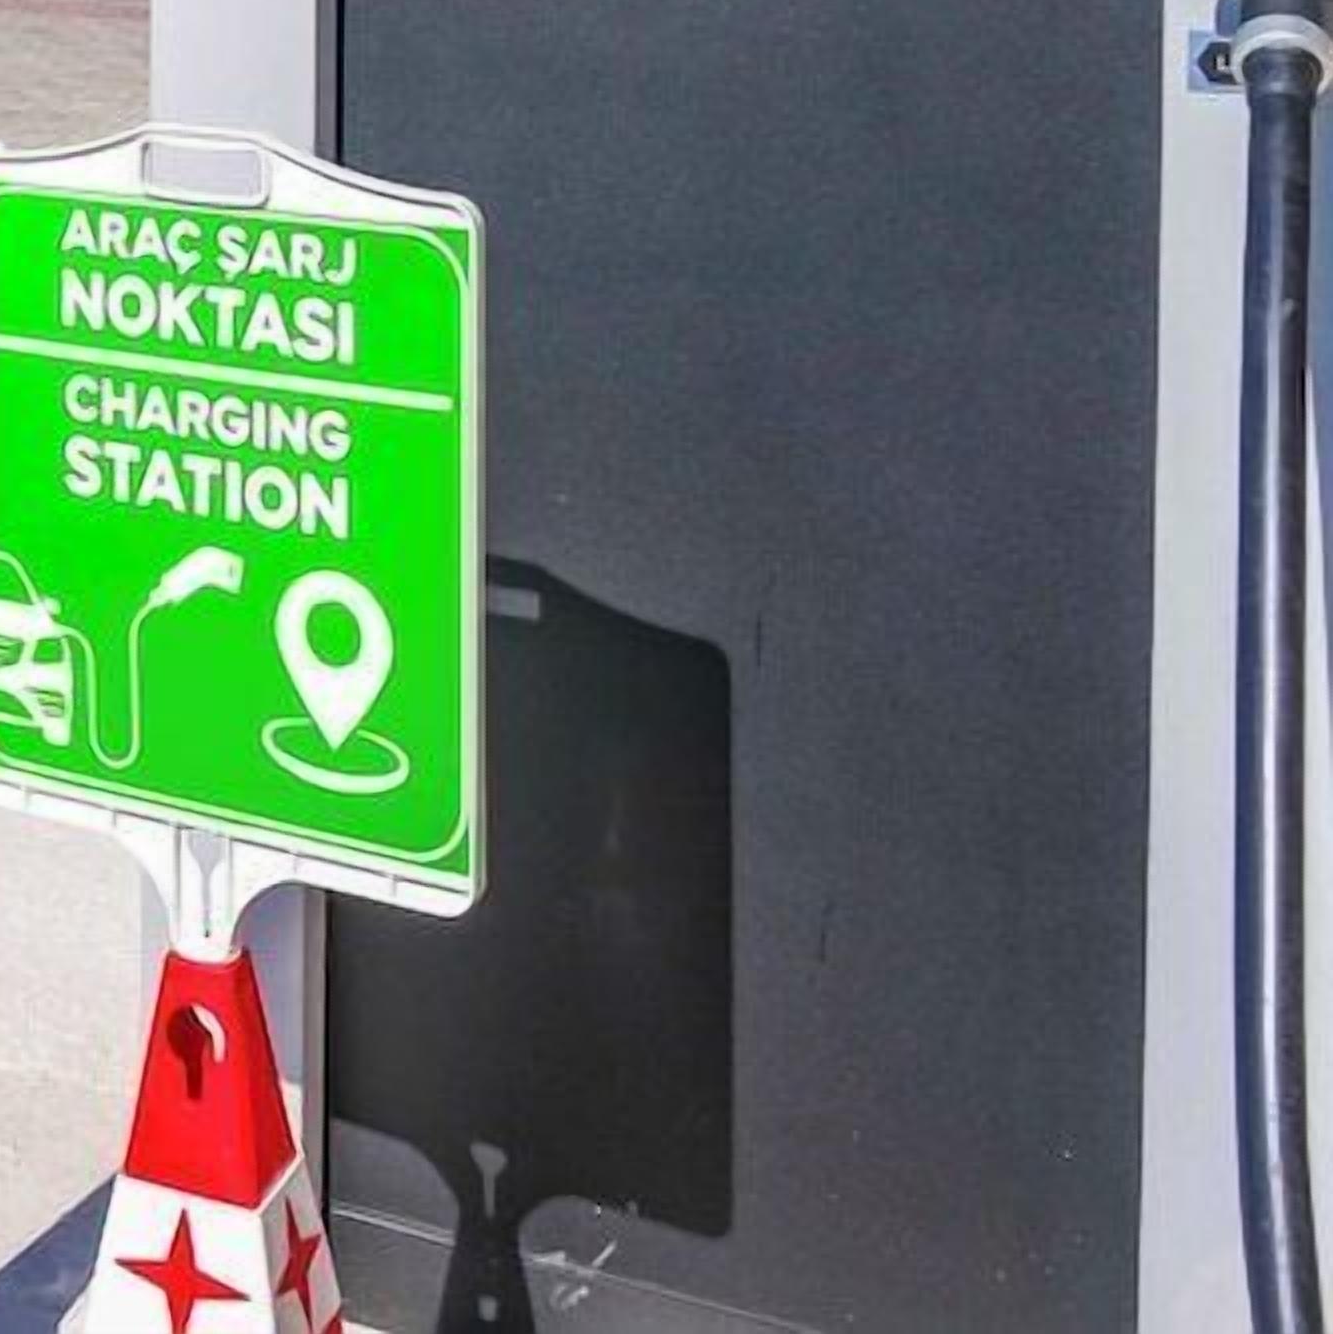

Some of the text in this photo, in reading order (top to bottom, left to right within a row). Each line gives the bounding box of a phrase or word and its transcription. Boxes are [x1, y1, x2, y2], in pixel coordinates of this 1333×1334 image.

[61, 209, 357, 287] ARAÇ ŞARJ
[61, 267, 355, 365] NOKTASI
[64, 373, 351, 462] CHARGING
[64, 434, 350, 540] STATION
